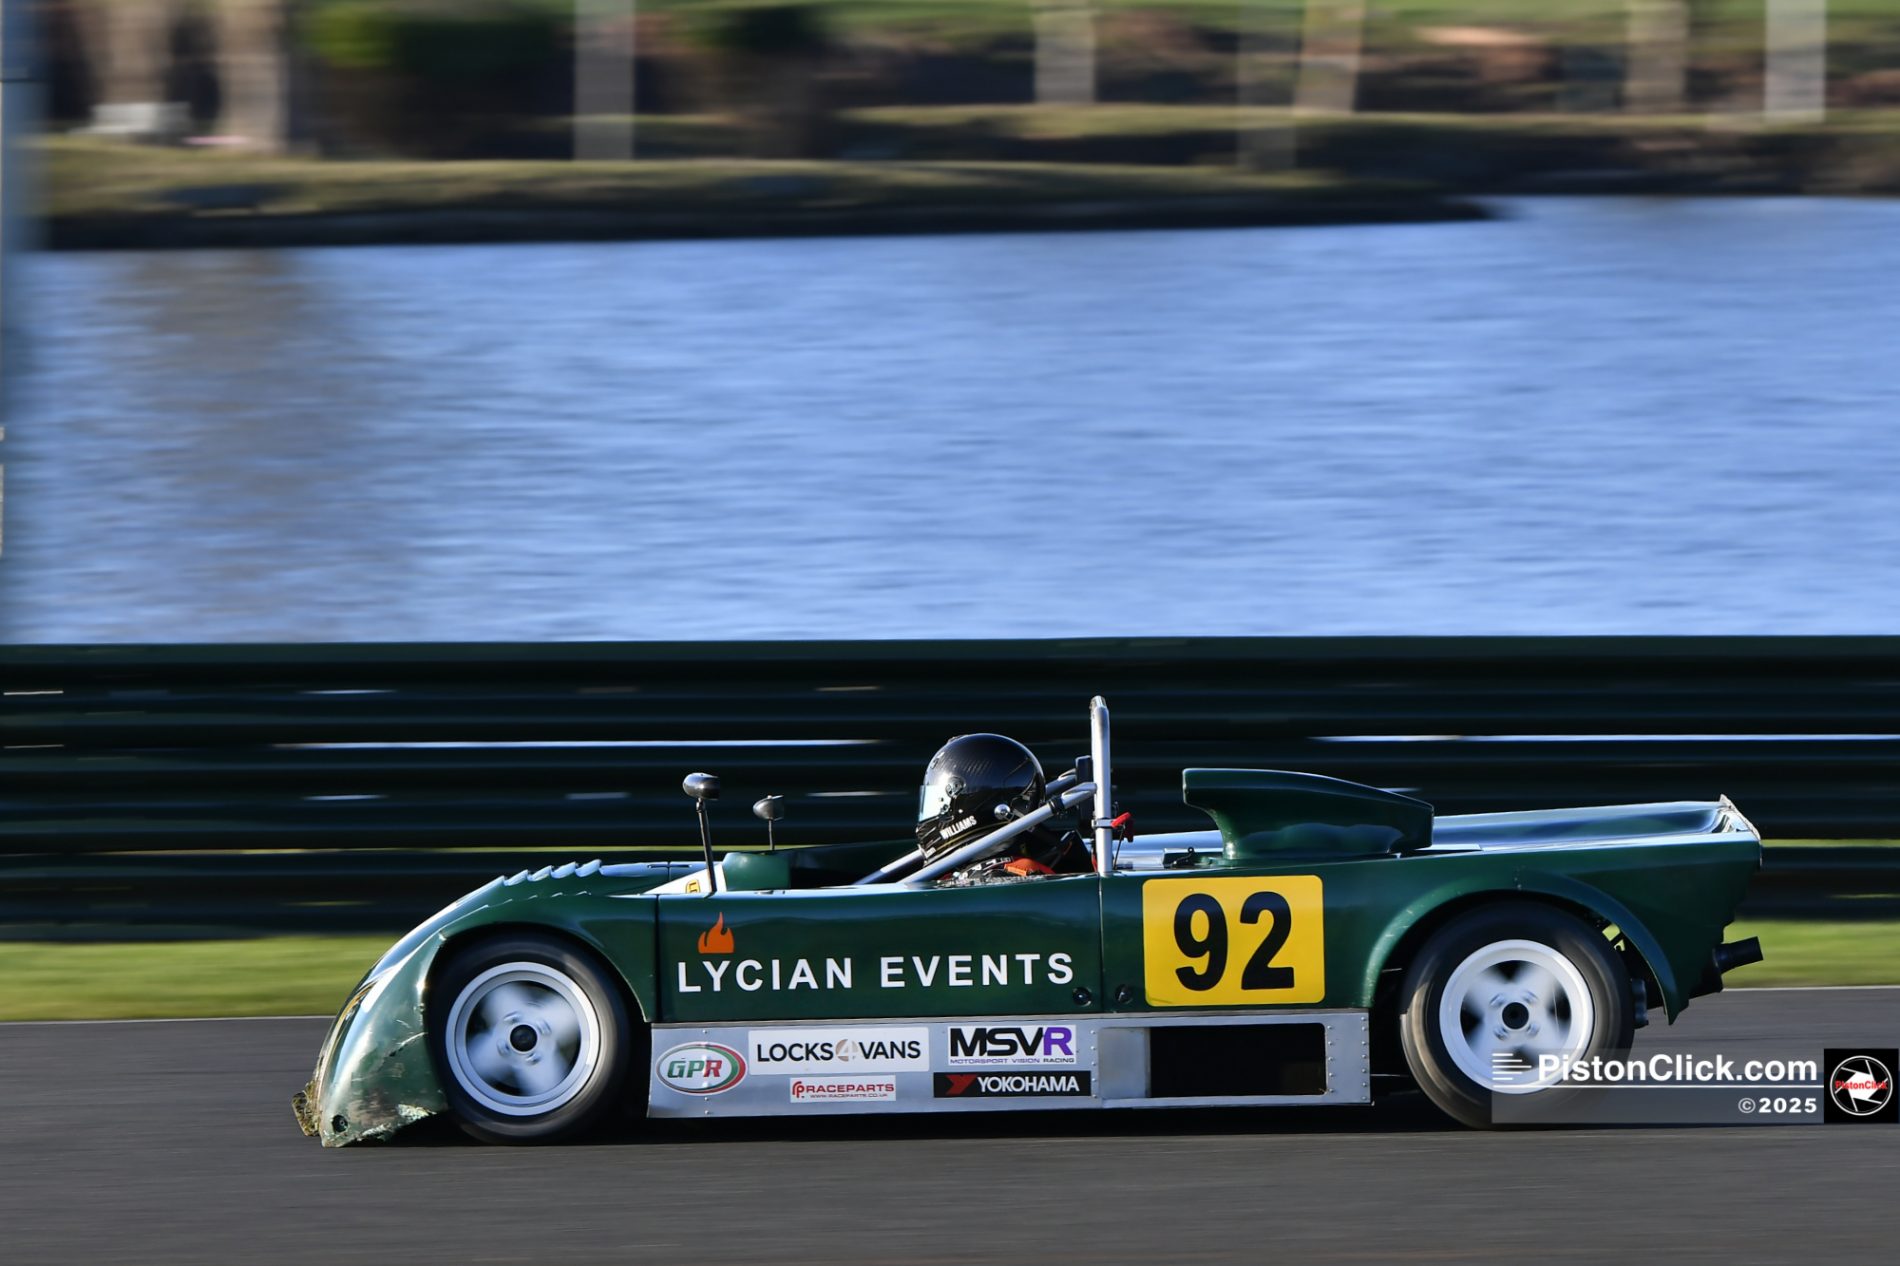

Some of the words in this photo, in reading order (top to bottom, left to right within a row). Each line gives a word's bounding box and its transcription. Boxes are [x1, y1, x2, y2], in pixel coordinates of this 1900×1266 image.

[940, 816, 977, 839] WILLIAMS
[1174, 892, 1295, 991] 92
[677, 957, 853, 992] LYCIAN
[880, 953, 1074, 988] EVENTS
[950, 1027, 1074, 1057] MSVR
[667, 1060, 723, 1078] GPR
[806, 1084, 894, 1093] RACEPARTS
[977, 1076, 1080, 1092] YOKOHAMA
